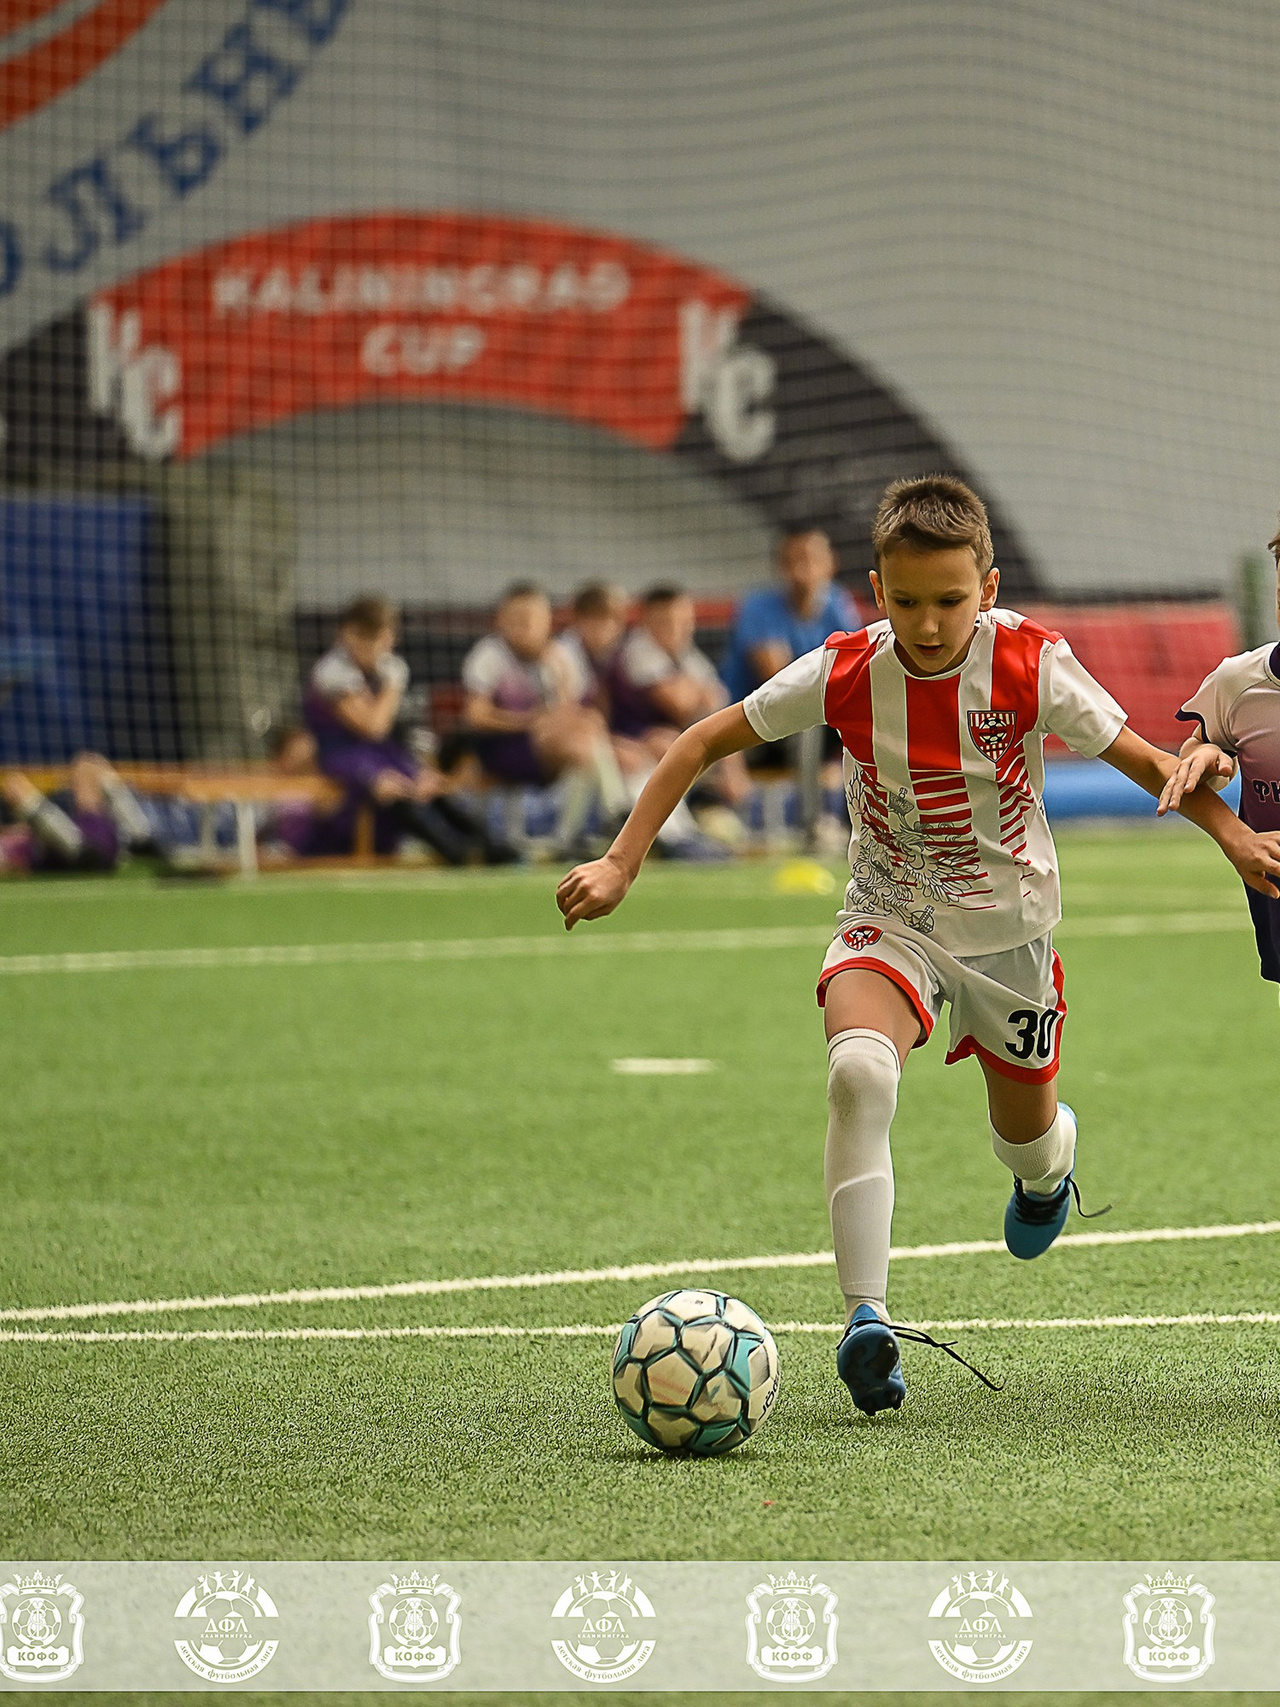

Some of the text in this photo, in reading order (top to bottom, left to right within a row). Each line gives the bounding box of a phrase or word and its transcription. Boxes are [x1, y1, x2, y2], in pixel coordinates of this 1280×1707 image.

[213, 262, 631, 317] KALININGRAD
[360, 322, 486, 377] CUP
[1004, 1008, 1060, 1060] 30
